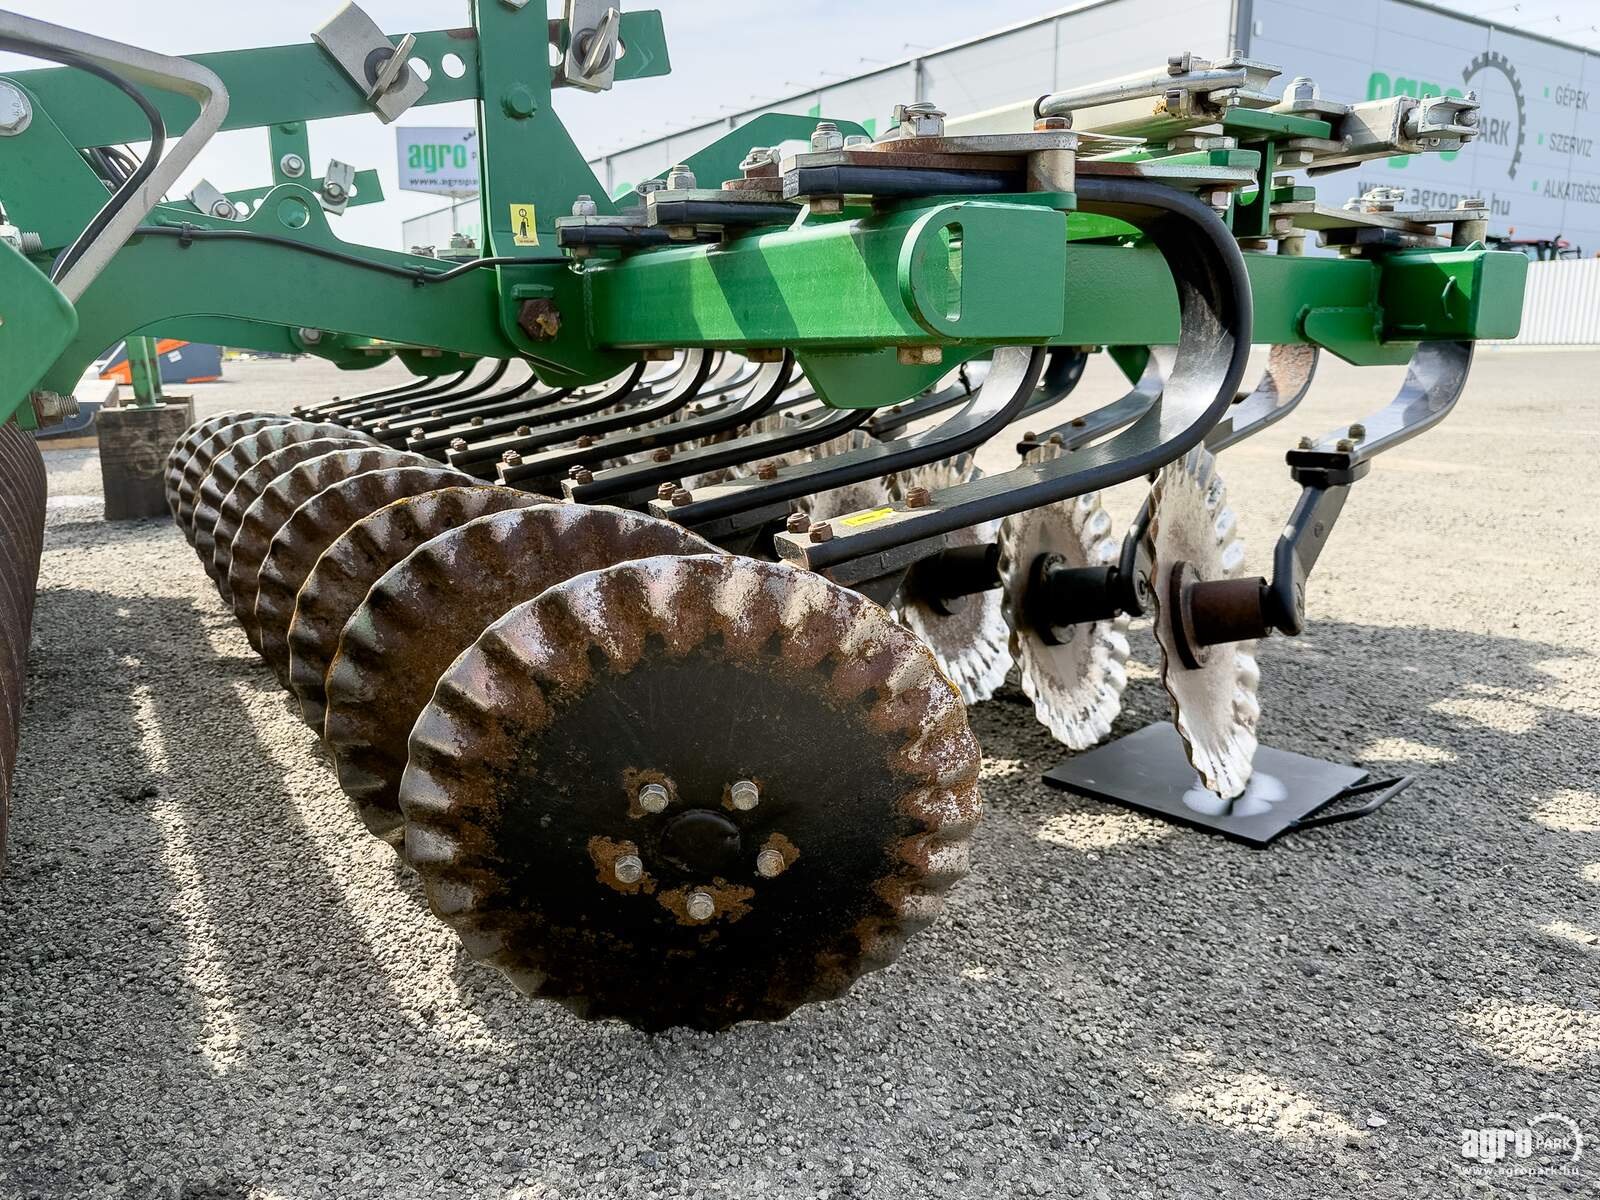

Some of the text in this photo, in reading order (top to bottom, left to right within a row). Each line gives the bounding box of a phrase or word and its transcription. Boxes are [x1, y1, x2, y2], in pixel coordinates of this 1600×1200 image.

[1555, 83, 1590, 111] GÉPEK
[1477, 116, 1511, 147] ARK
[1549, 132, 1593, 158] SZERVIZ
[408, 144, 467, 173] agro
